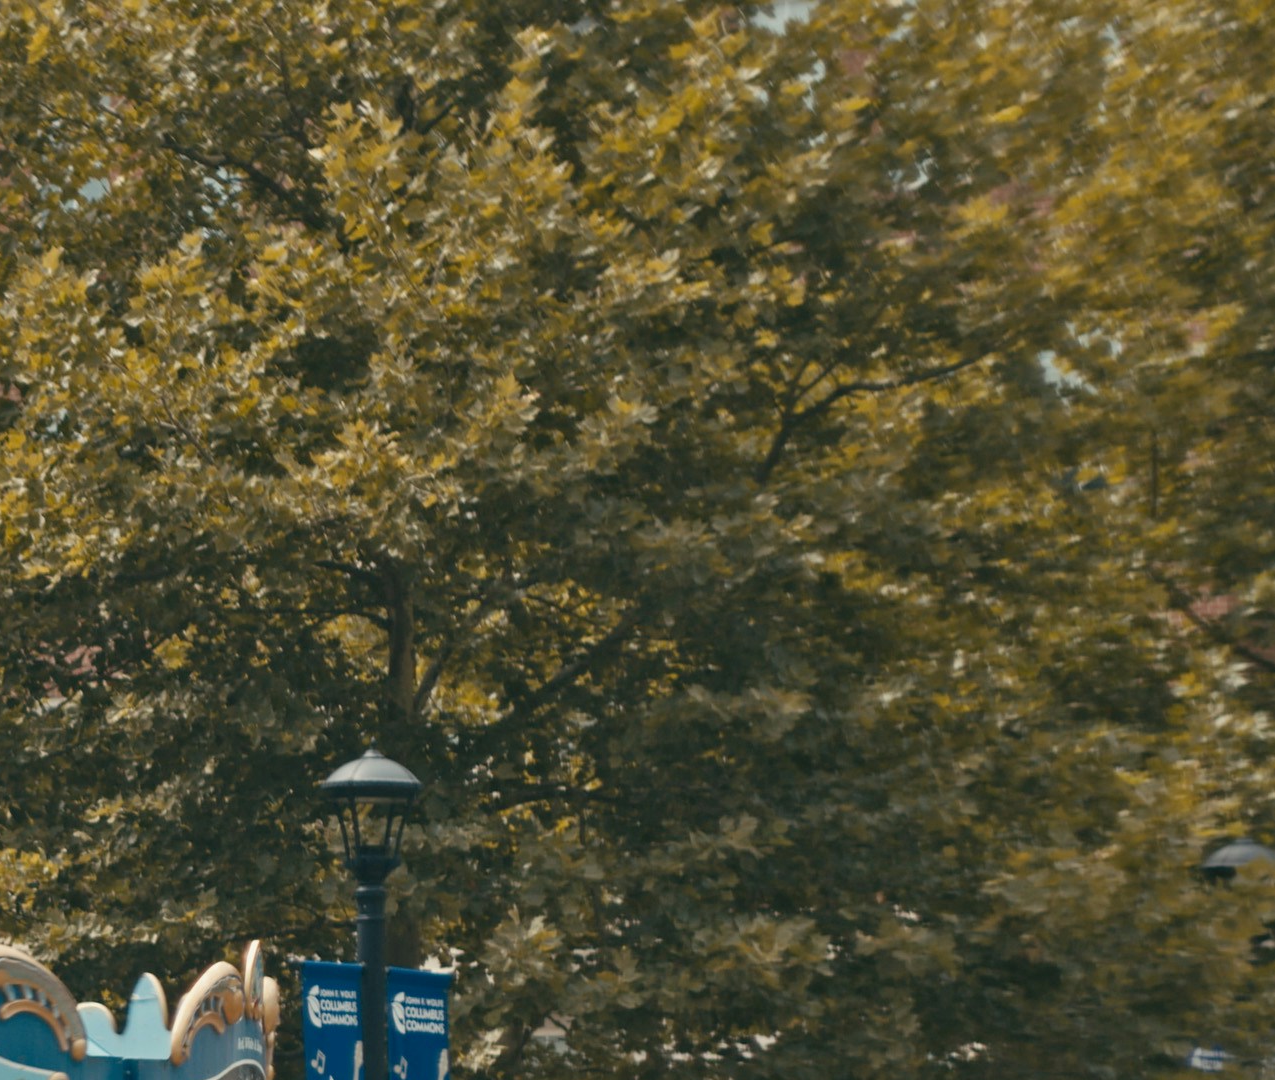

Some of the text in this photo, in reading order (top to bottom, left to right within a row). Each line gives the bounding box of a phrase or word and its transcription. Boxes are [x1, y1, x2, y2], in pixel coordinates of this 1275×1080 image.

[320, 999, 358, 1012] COLUMBUS
[405, 1005, 444, 1020] COLUMBUS
[321, 1012, 358, 1026] COMMONS
[405, 1020, 445, 1035] COMMONS
